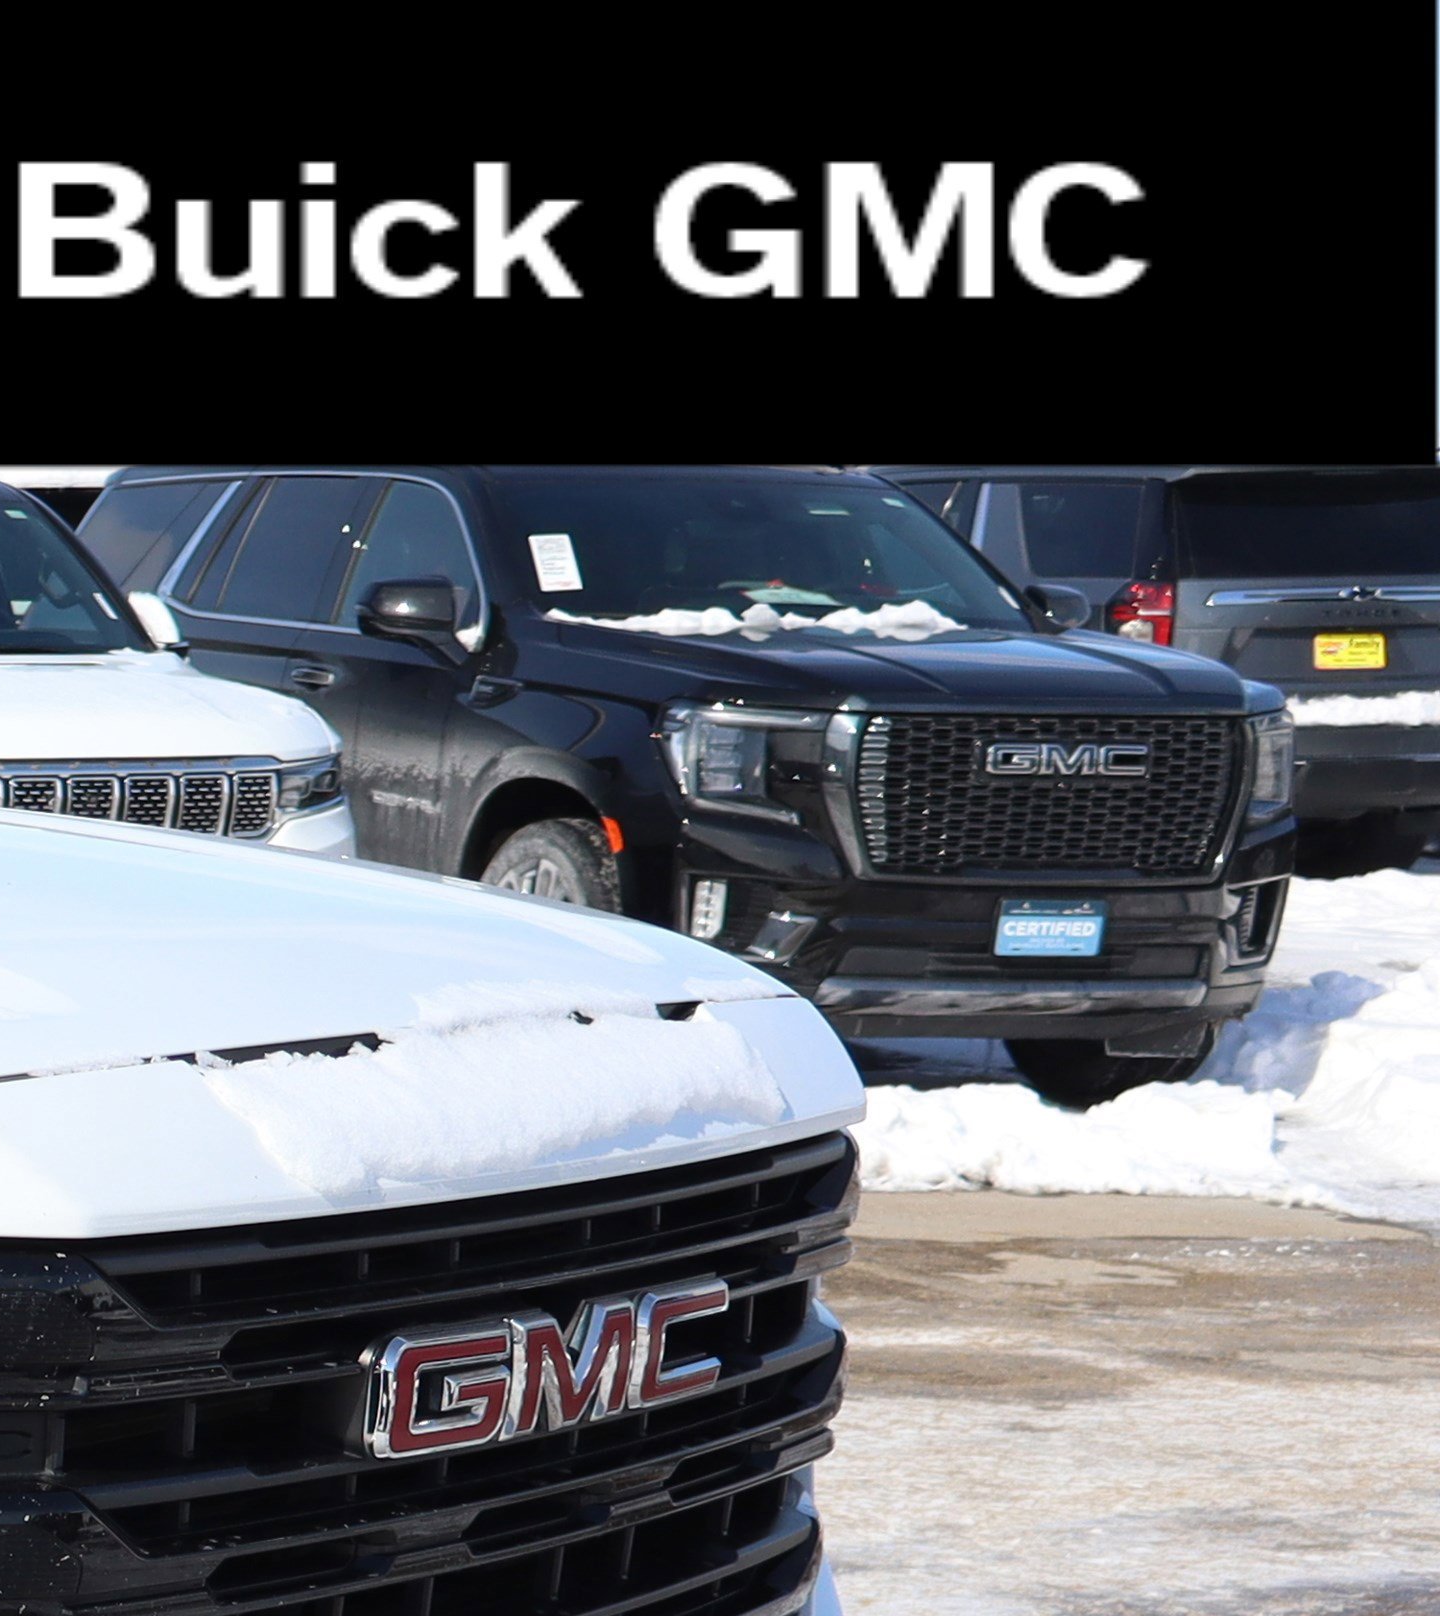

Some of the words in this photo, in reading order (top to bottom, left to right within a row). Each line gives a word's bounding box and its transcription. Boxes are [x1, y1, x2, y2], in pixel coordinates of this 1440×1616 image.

[984, 742, 1148, 776] GMC
[1003, 920, 1097, 937] CERTIFIED
[371, 1278, 730, 1460] GMC
